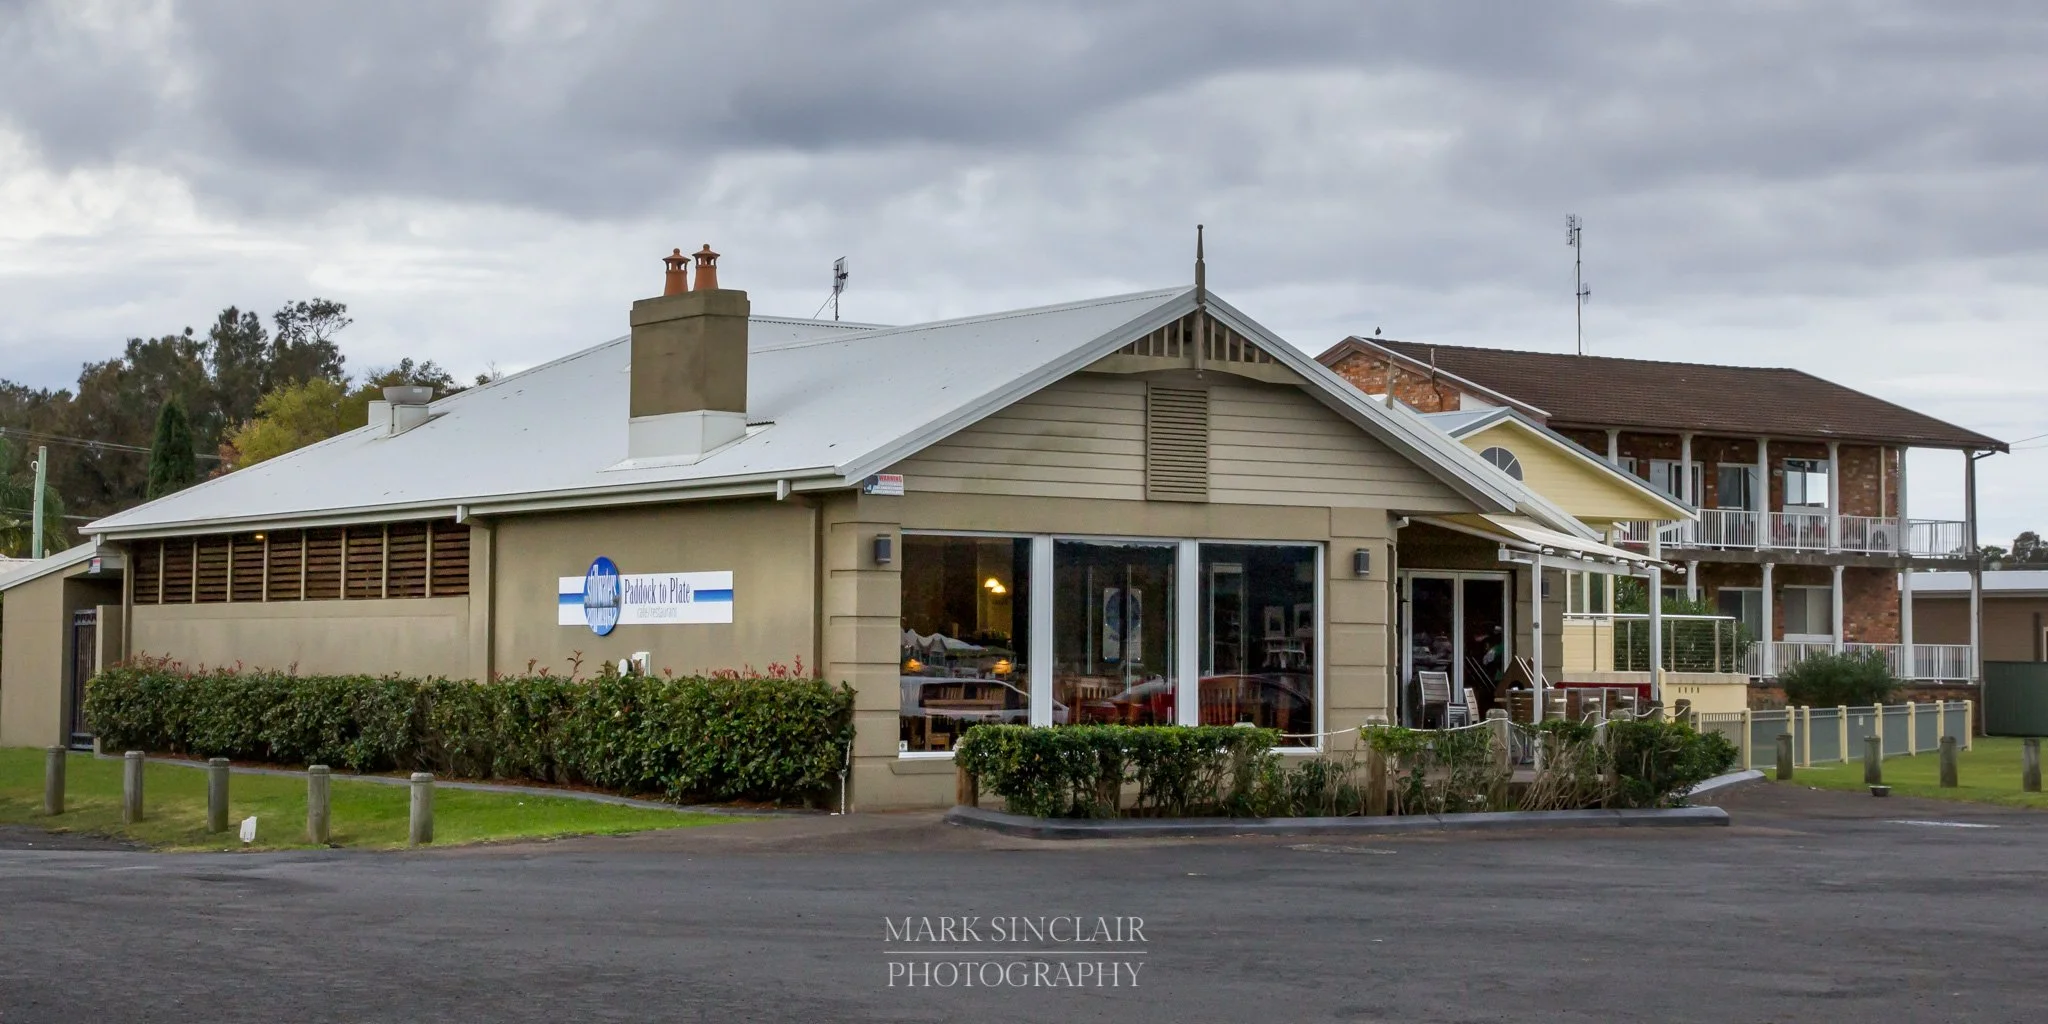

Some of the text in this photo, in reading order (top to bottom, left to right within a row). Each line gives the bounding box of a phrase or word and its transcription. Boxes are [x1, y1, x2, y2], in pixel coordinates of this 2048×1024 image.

[624, 577, 690, 605] Paddock to Plate
